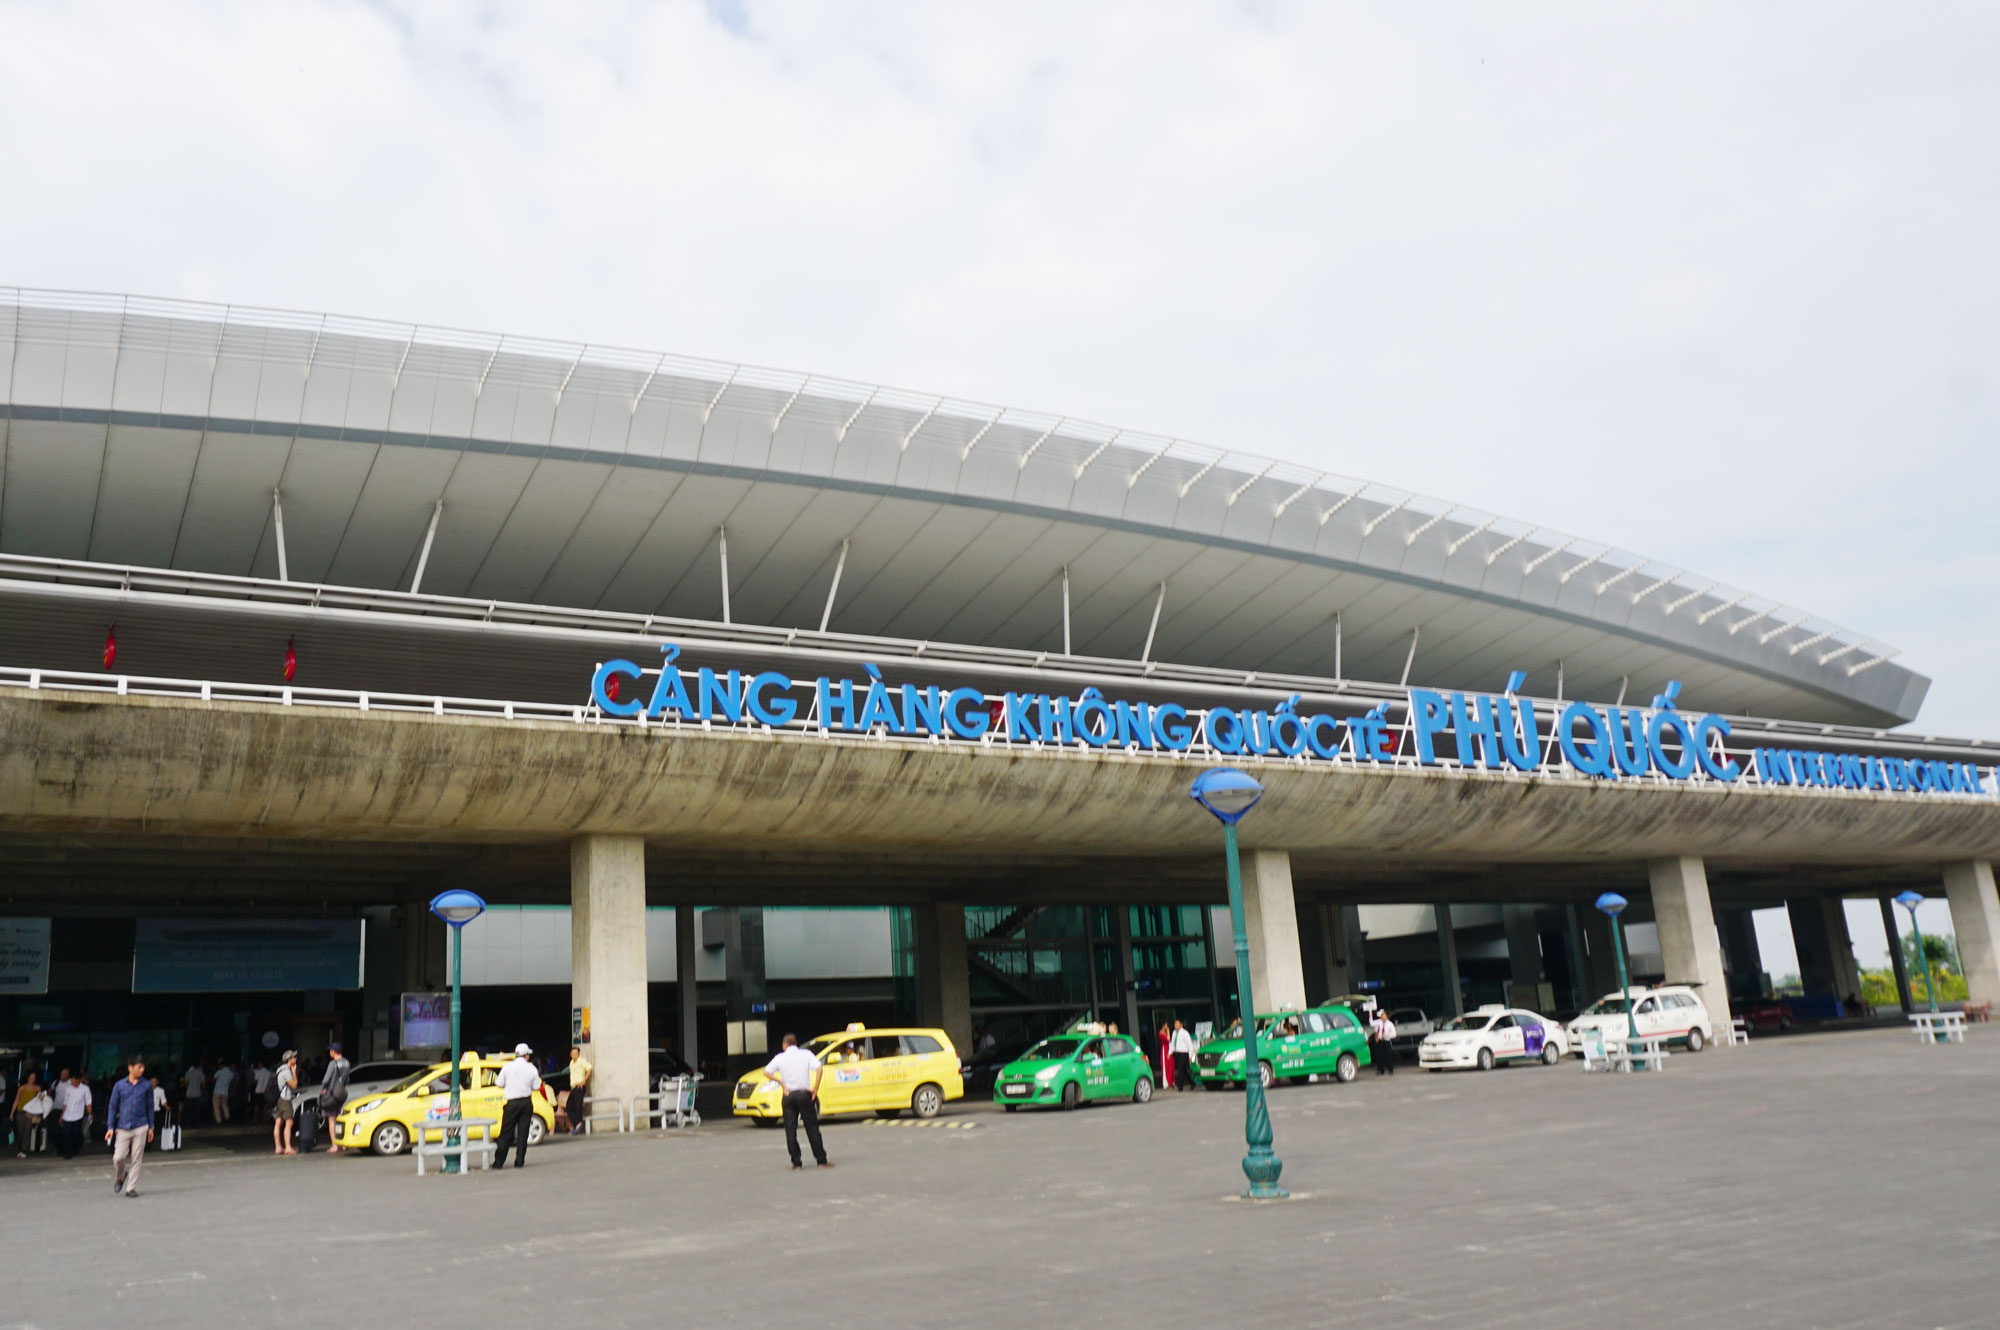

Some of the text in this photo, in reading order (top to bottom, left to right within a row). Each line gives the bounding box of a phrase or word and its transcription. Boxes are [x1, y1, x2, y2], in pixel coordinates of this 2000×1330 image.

[591, 643, 1986, 794] CẢNG HÀNG KHÔNG QUỐC TẾ PHÚ QUỐC INTERNATIONAL
